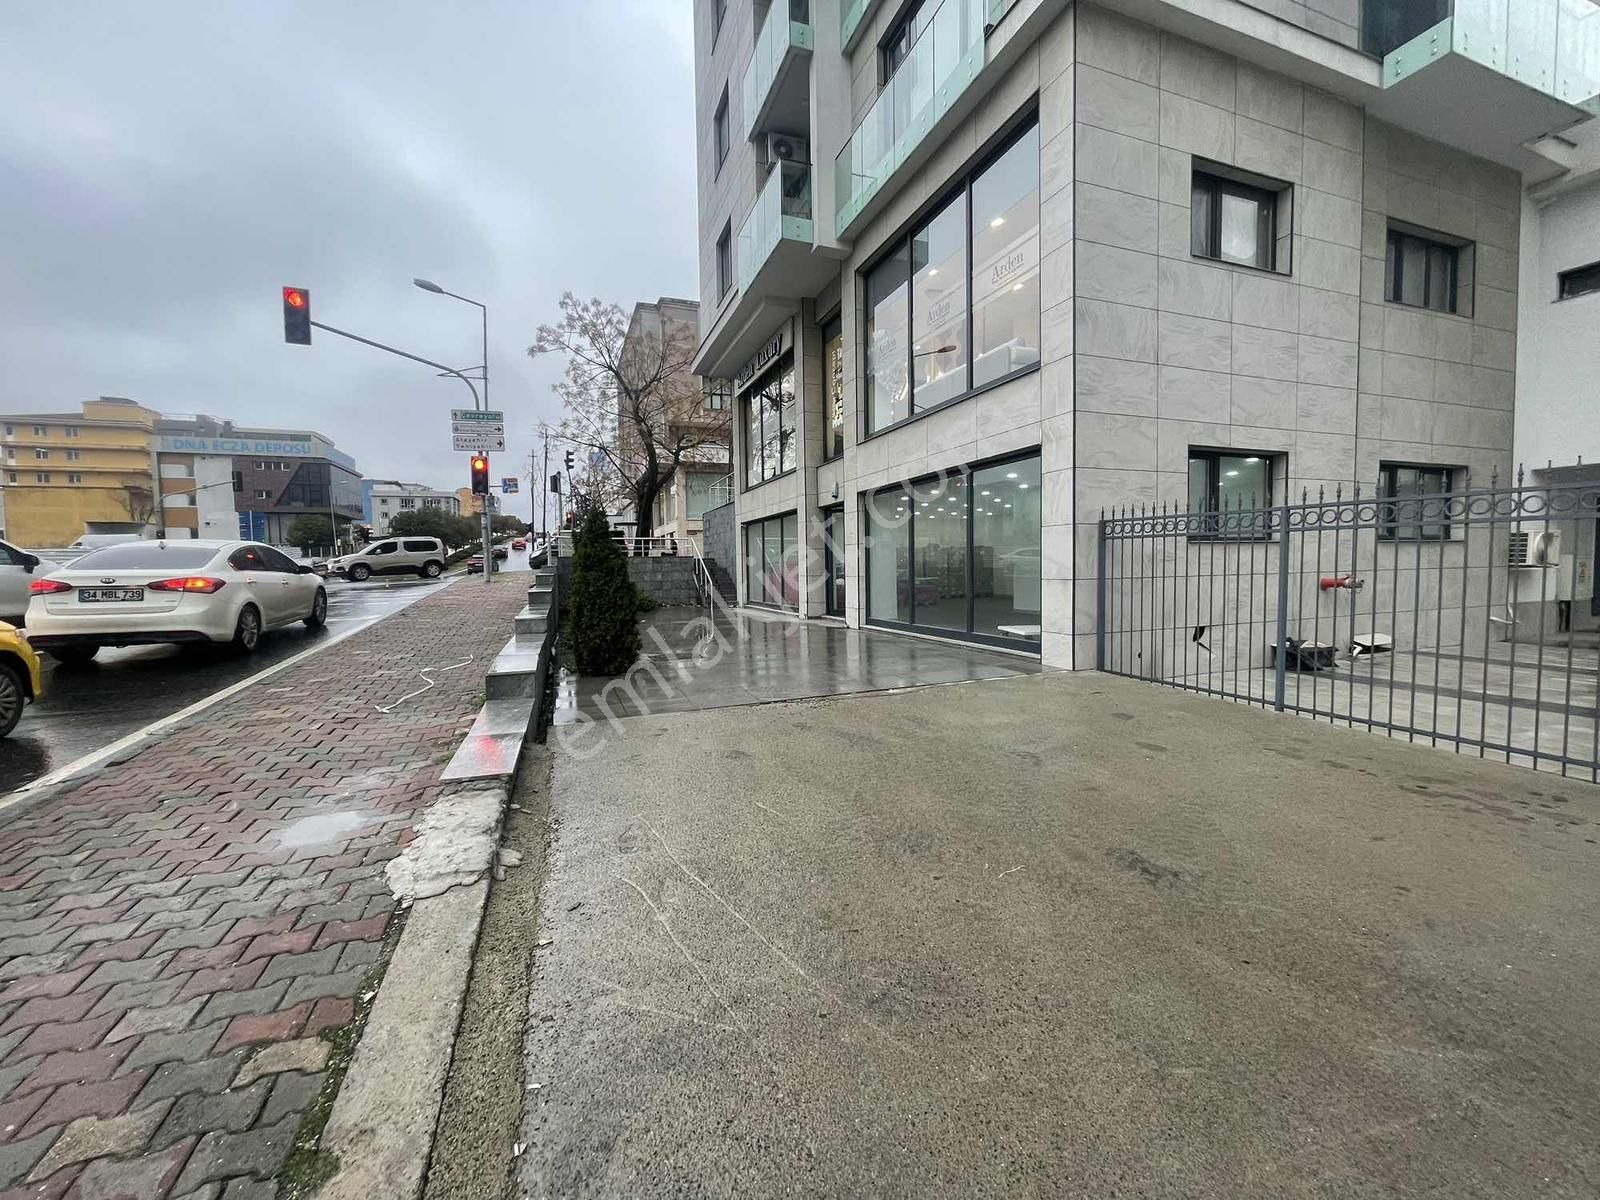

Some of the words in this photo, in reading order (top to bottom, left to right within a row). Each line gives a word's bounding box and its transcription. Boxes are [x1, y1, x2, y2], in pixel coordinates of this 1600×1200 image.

[991, 252, 1025, 281] Arden
[927, 302, 951, 323] Arden
[174, 439, 208, 450] DNA
[212, 440, 249, 452] ECZA
[255, 442, 311, 454] DEPOSU
[85, 591, 97, 599] 34
[101, 591, 120, 599] MBL
[123, 590, 141, 598] 739
